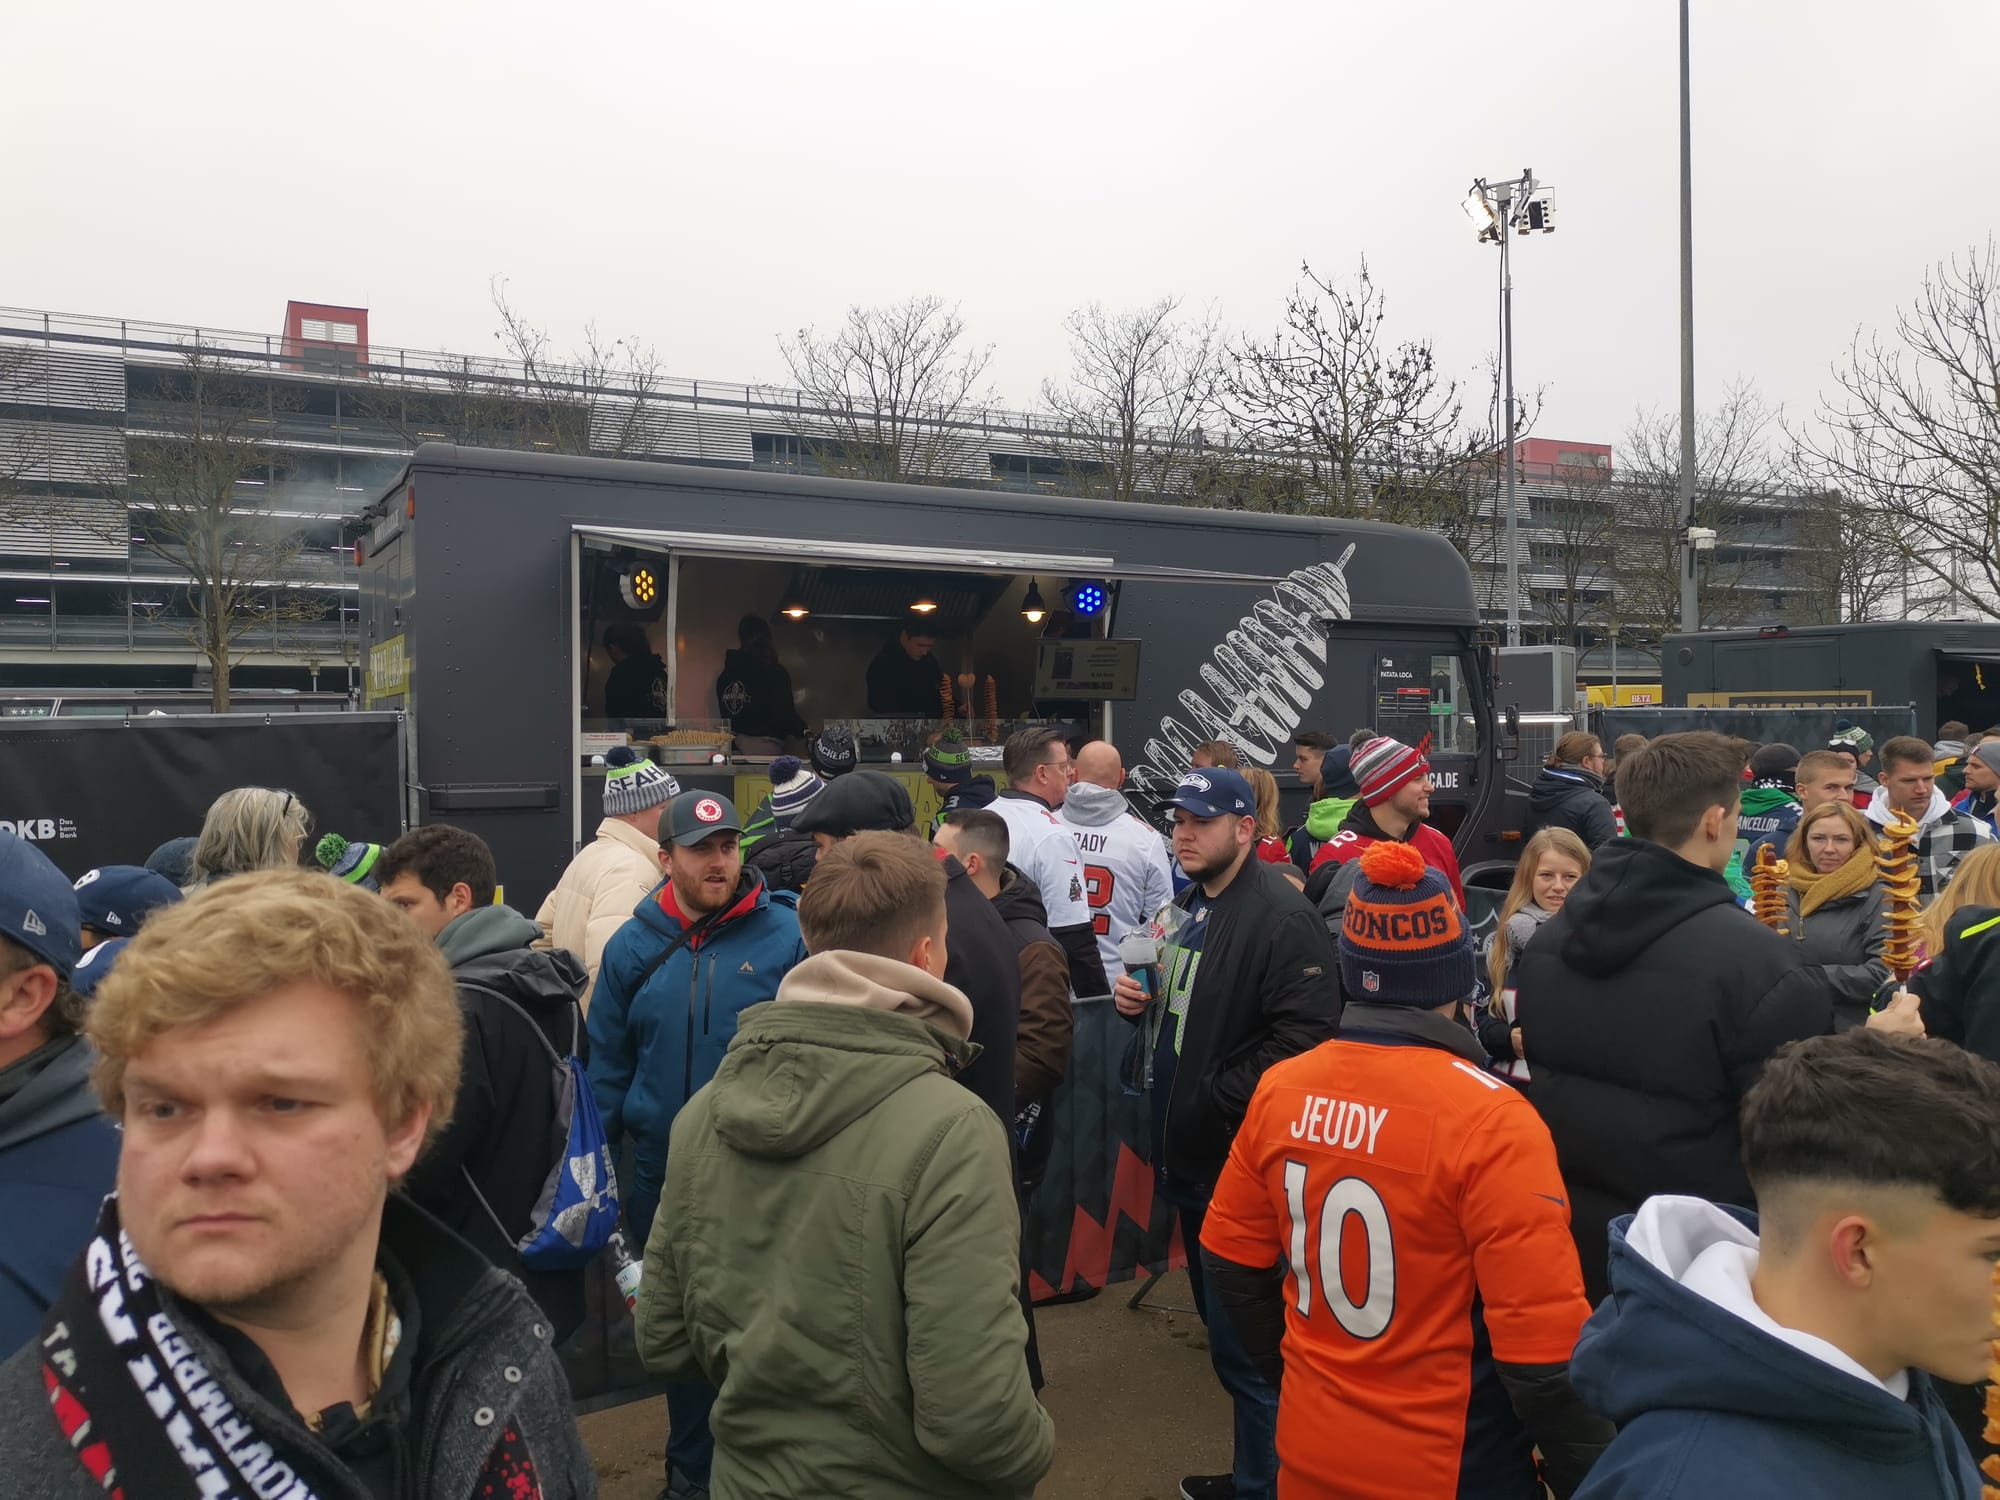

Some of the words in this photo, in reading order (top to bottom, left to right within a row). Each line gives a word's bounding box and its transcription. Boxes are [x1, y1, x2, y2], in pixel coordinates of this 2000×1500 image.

[1399, 671, 1413, 679] LOCA
[608, 765, 672, 793] SEAH
[1425, 772, 1459, 788] CA.DE
[1290, 1094, 1389, 1154] JEUDY
[1284, 1158, 1397, 1341] 10
